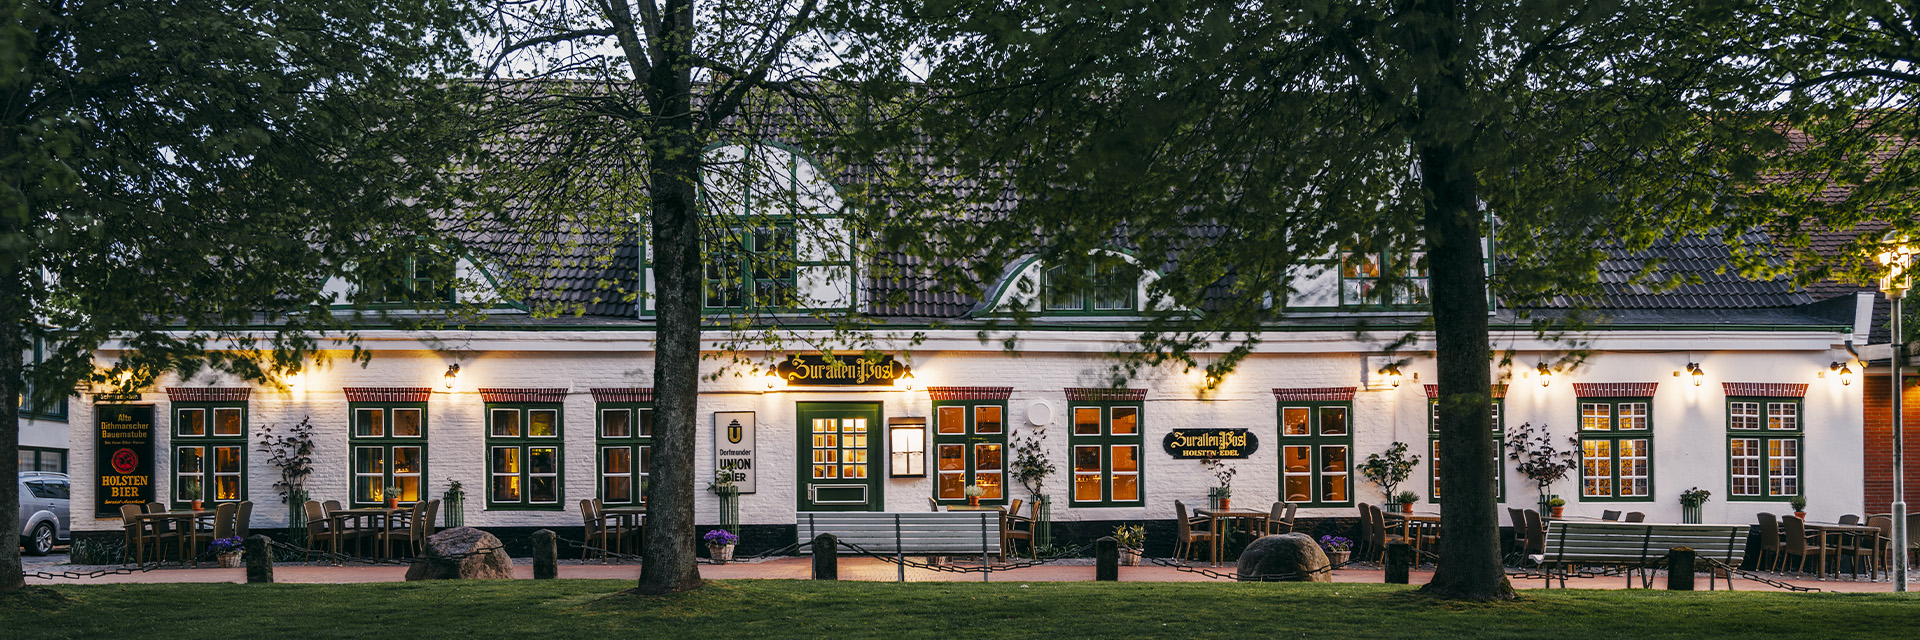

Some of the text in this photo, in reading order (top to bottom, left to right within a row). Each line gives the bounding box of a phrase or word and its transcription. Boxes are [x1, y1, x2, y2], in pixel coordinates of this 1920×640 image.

[856, 358, 894, 384] Post
[118, 413, 132, 421] Alte
[101, 421, 149, 430] Dithmarscher
[102, 430, 147, 438] Bauernstube
[1219, 431, 1246, 449] Post
[720, 448, 751, 456] Dortmunder
[720, 458, 751, 470] UNION
[102, 475, 148, 486] HOLSTEN
[111, 486, 139, 497] BIER
